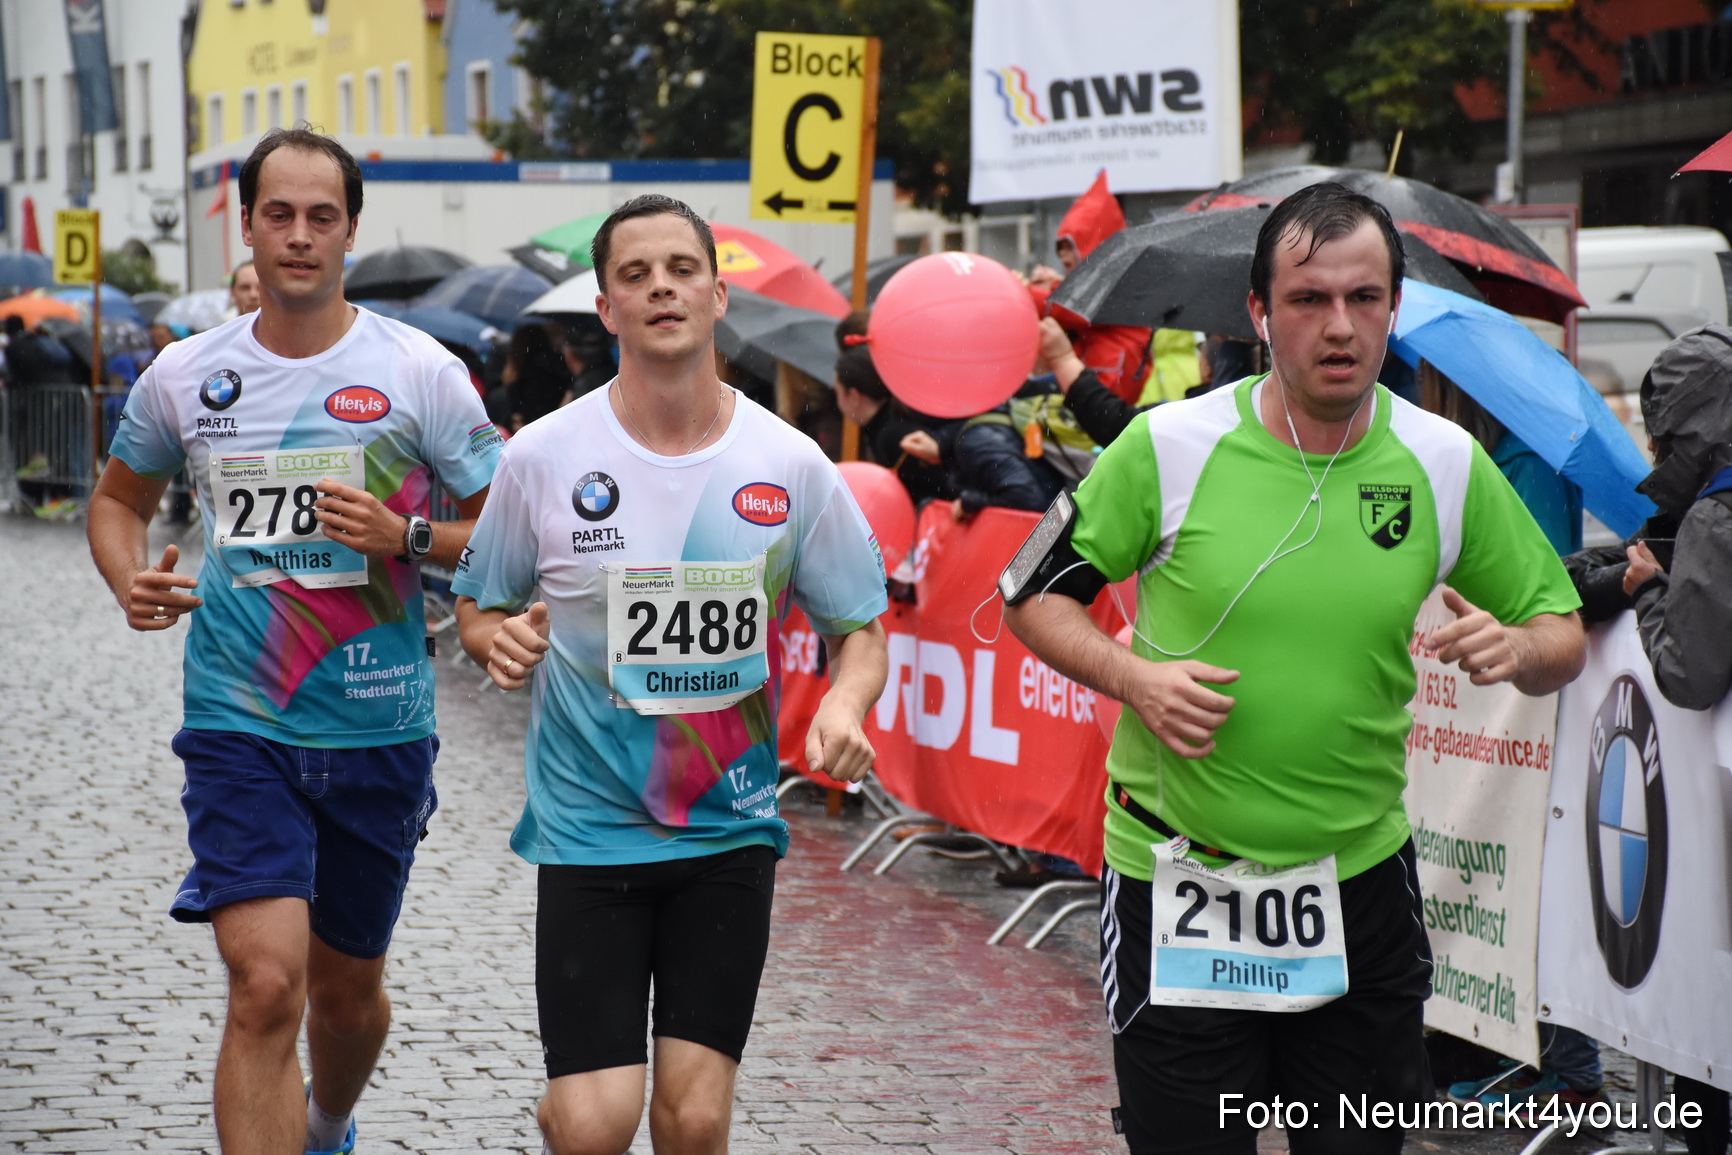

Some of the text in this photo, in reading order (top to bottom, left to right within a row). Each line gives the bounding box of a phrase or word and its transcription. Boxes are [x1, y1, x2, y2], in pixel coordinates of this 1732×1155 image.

[771, 42, 863, 78] Block
[783, 92, 844, 182] C
[66, 232, 88, 266] D
[206, 370, 241, 384] BMW
[334, 395, 383, 414] Hervis
[195, 429, 238, 438] Neumarkt
[196, 417, 239, 430] PARTL
[220, 469, 268, 478] NeuerMarkt
[276, 452, 351, 473] BOCK
[576, 472, 615, 491] BMW
[1361, 486, 1410, 494] EZELSDORF
[229, 485, 346, 538] 278
[741, 493, 788, 515] Hervis
[1372, 503, 1385, 525] F
[572, 527, 625, 545] PARTL
[1388, 518, 1403, 541] C
[573, 540, 626, 555] Neumarkt
[622, 580, 675, 589] NeuerMarkt
[684, 565, 756, 586] BOCK
[627, 597, 758, 655] 2488
[343, 642, 378, 667] 17.
[344, 663, 415, 682] Neumarkter
[646, 670, 739, 693] Christian
[345, 681, 406, 699] Stadtlauf
[1427, 672, 1440, 707] 63
[1443, 674, 1457, 709] 52
[1592, 682, 1660, 787] BMW
[728, 765, 752, 794] 17.
[1175, 880, 1326, 948] 2106
[1212, 958, 1289, 993] Phillip
